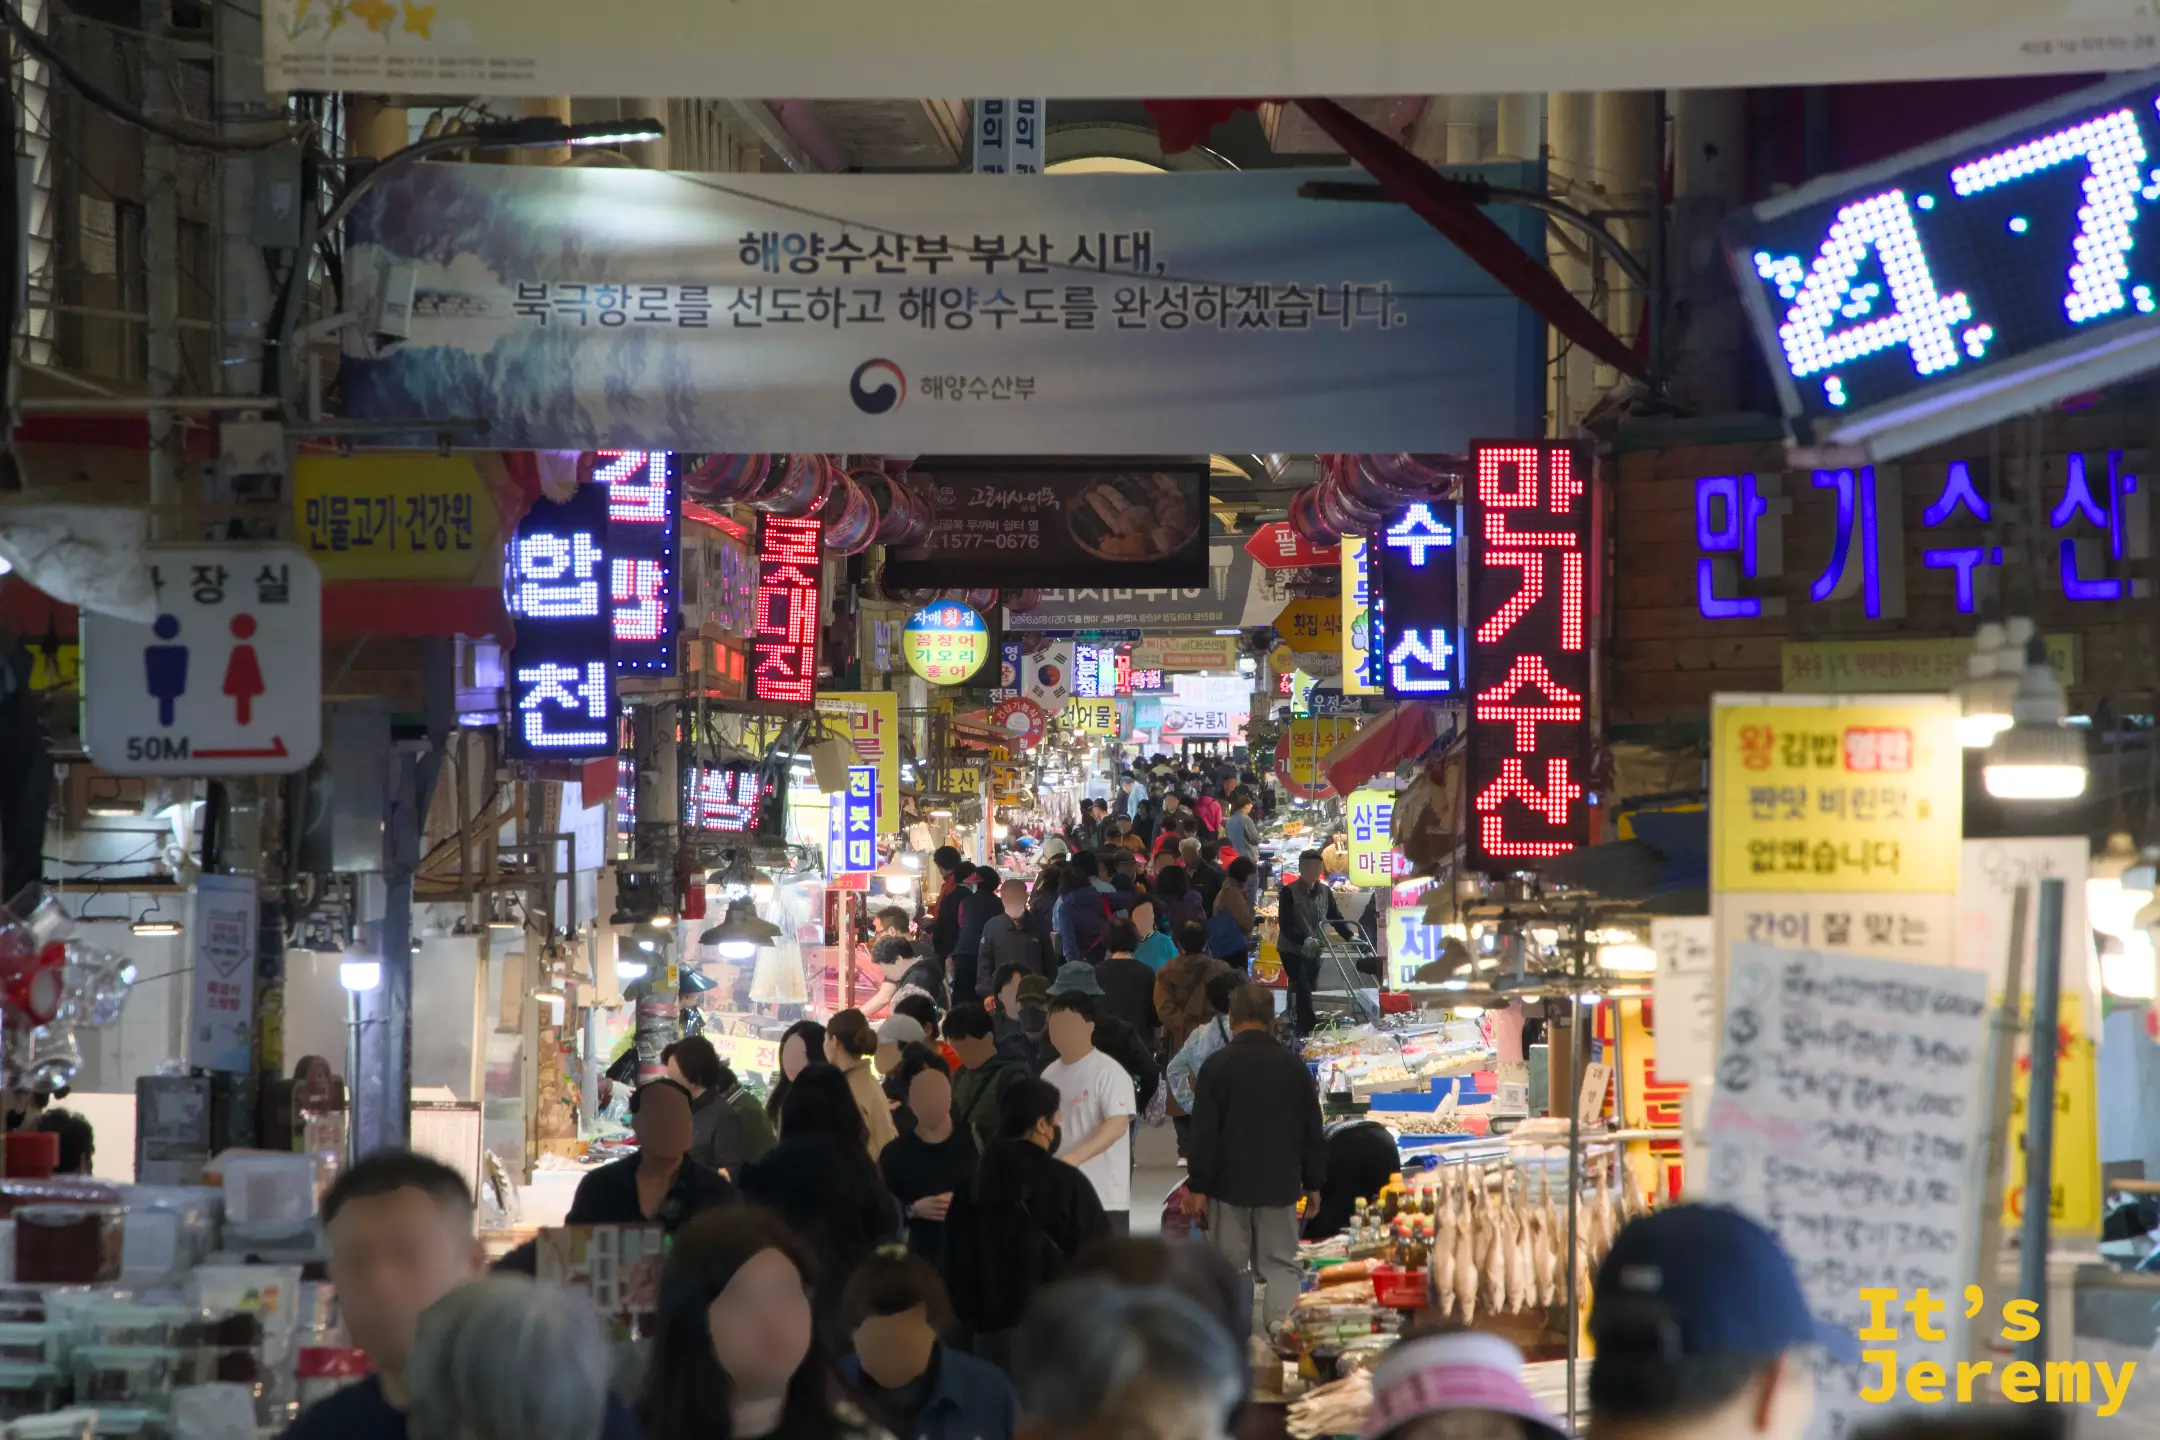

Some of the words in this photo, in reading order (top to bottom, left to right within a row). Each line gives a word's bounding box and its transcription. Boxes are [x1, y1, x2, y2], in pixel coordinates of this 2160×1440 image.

[739, 231, 953, 274] 해양수산부
[969, 233, 1054, 274] 부산
[1068, 230, 1166, 278] 시대,
[512, 282, 712, 328] 북극항로를
[727, 285, 885, 329] 선도하고
[899, 285, 1098, 330] 해양수도를
[1111, 283, 1406, 330] 완성하겠습니다.
[920, 375, 1036, 400] 해양수산부
[1696, 450, 2137, 619] 만기수산
[150, 564, 290, 605] 장실
[1387, 504, 1453, 691] 수산
[914, 608, 975, 627] 자매횟집
[915, 633, 975, 648] 꼼장어
[915, 649, 974, 663] 가오리
[1477, 449, 1583, 856] 만기수산
[926, 665, 966, 678] 홍어
[127, 736, 190, 761] 50M
